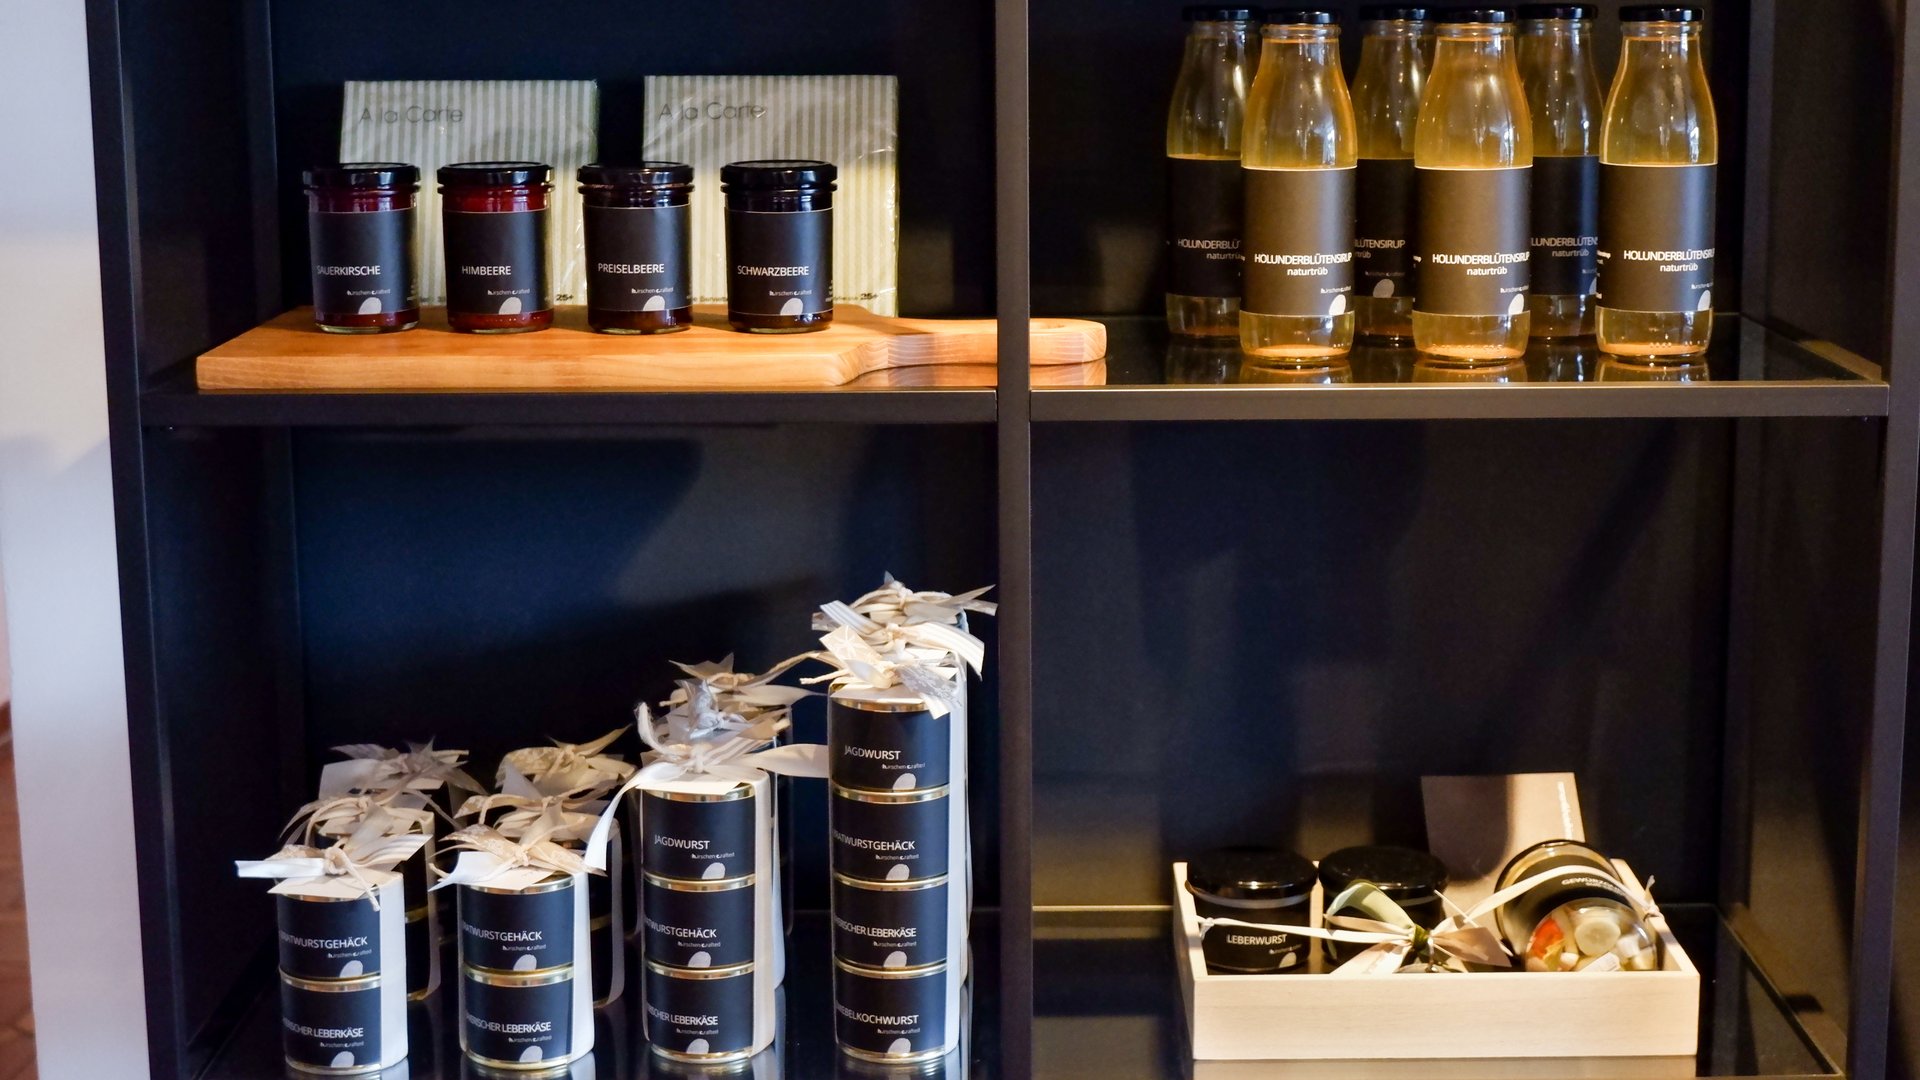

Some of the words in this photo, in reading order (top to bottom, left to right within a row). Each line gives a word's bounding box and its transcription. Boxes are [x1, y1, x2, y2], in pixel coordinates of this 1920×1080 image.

[359, 107, 372, 123] A
[380, 107, 398, 124] la
[406, 105, 463, 123] Carte
[659, 103, 673, 120] A
[680, 103, 699, 120] la
[706, 101, 764, 121] Carte
[1355, 238, 1406, 249] LÜTENSIRUP
[1206, 252, 1242, 260] naturtrü
[1254, 251, 1352, 266] HOLUNDERBLÜTENSIRUP
[1551, 249, 1590, 258] naturtrüb
[316, 265, 381, 276] SAUERKIRSCHE
[461, 265, 512, 276] HIMBEERE
[597, 262, 665, 274] PREISELBEERE
[737, 264, 809, 276] SCHWARZBEERE
[1287, 266, 1329, 276] naturtrüb
[1466, 266, 1508, 276] naturtrüb
[1660, 262, 1699, 272] naturtrüb
[844, 745, 902, 761] JAGDWURST
[654, 834, 710, 850] JAGDWURST
[867, 926, 917, 938] LEBERKÄSE
[1226, 933, 1288, 946] LEBERWURST
[670, 1014, 719, 1026] LEBERKÄSE
[313, 1026, 364, 1039] LEBERKÄSE
[502, 1021, 552, 1034] LEBERKÄSE
